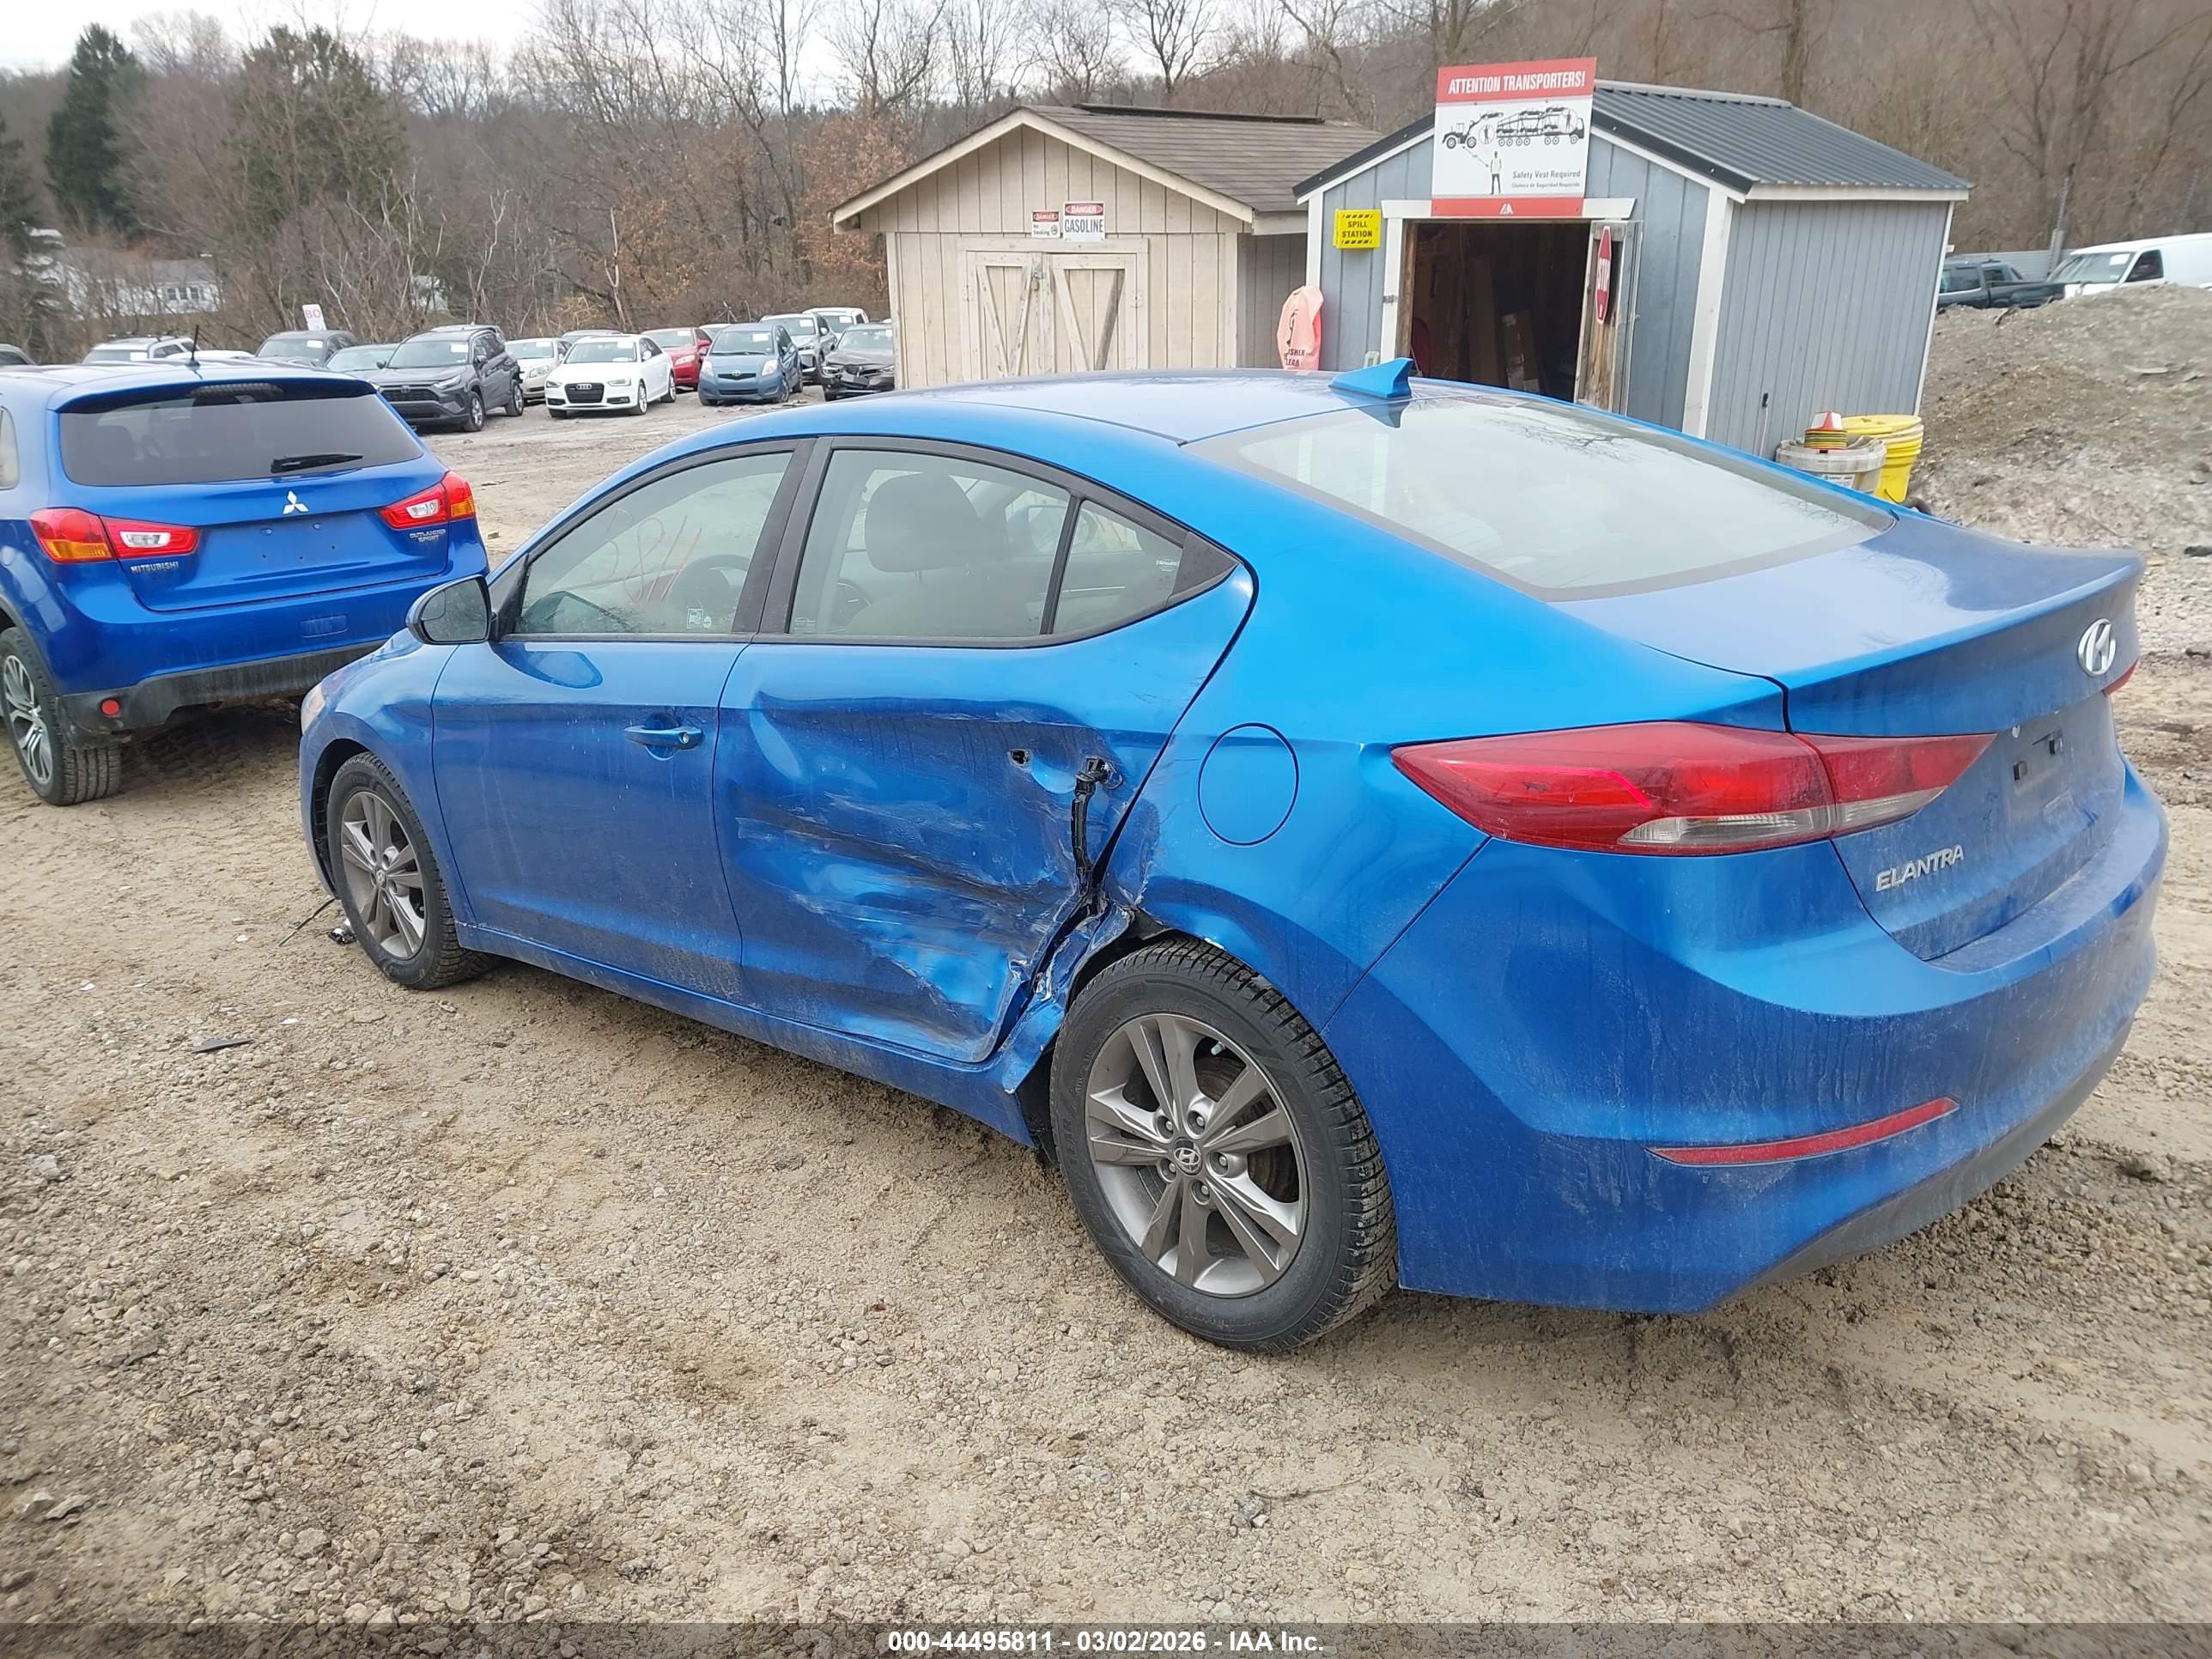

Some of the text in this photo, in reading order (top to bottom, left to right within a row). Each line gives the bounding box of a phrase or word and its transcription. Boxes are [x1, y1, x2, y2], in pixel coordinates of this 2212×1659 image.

[1448, 70, 1586, 94] ATTENTION TRANSPORTERS!
[1512, 171, 1533, 179] Safety
[1551, 169, 1581, 179] Required
[1065, 219, 1103, 233] GASOLINE
[131, 561, 179, 574] MITSUBISHI
[1875, 844, 1964, 891] ELANTRA
